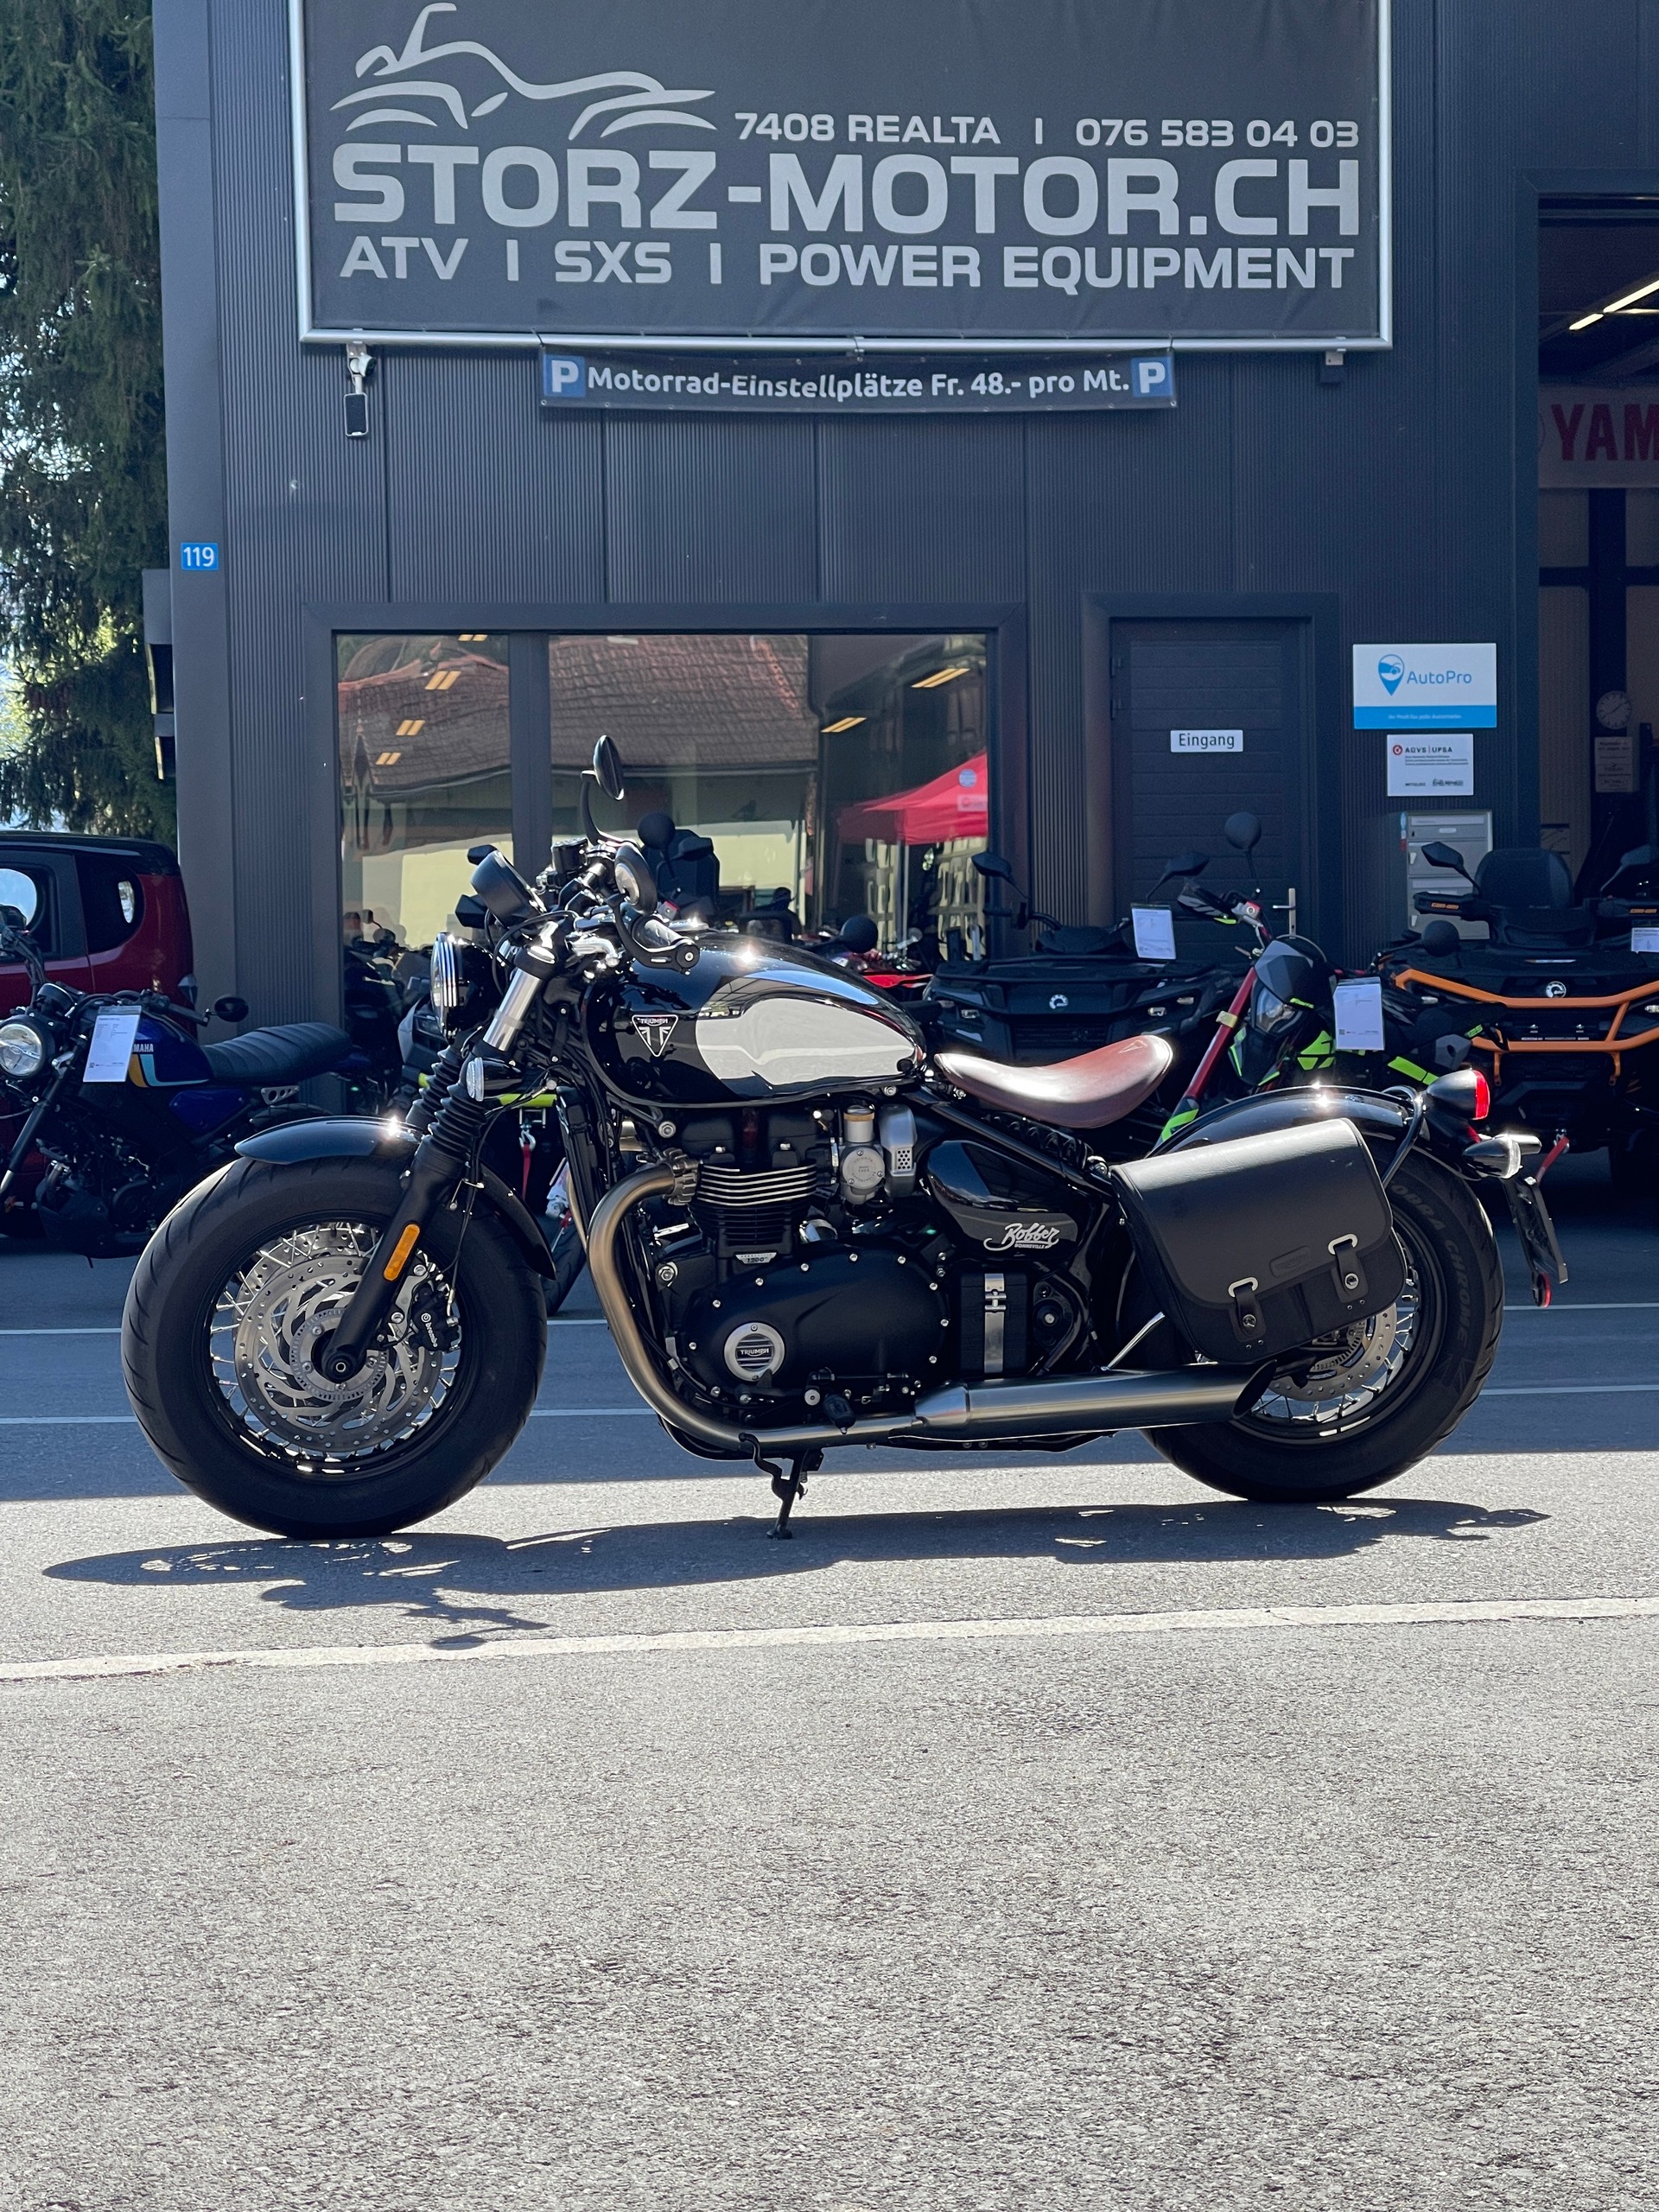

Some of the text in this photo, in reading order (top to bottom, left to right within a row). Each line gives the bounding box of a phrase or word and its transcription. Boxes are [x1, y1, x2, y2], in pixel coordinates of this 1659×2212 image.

[734, 112, 836, 142] 7408
[848, 115, 1001, 144] REALTA
[1076, 118, 1148, 147] 076
[1161, 119, 1235, 147] 583
[1246, 119, 1298, 148] 04
[1309, 120, 1359, 148] 03
[332, 142, 1359, 236] STORZ-MOTOR.CH
[339, 235, 469, 280] ATV
[554, 240, 672, 284] SXS
[760, 243, 981, 288] POWER
[1003, 245, 1355, 296] EQUIPMENT
[551, 359, 1166, 403] P Motorrad-Einstellplätze Fr. 48.- pro Mt. P
[183, 546, 215, 568] 119
[1406, 670, 1472, 684] AutoPro
[1178, 733, 1236, 750] Eingang
[1390, 1180, 1447, 1231] OBRA
[983, 1222, 1060, 1251] Bobber
[740, 1348, 770, 1357] TRIUMPH
